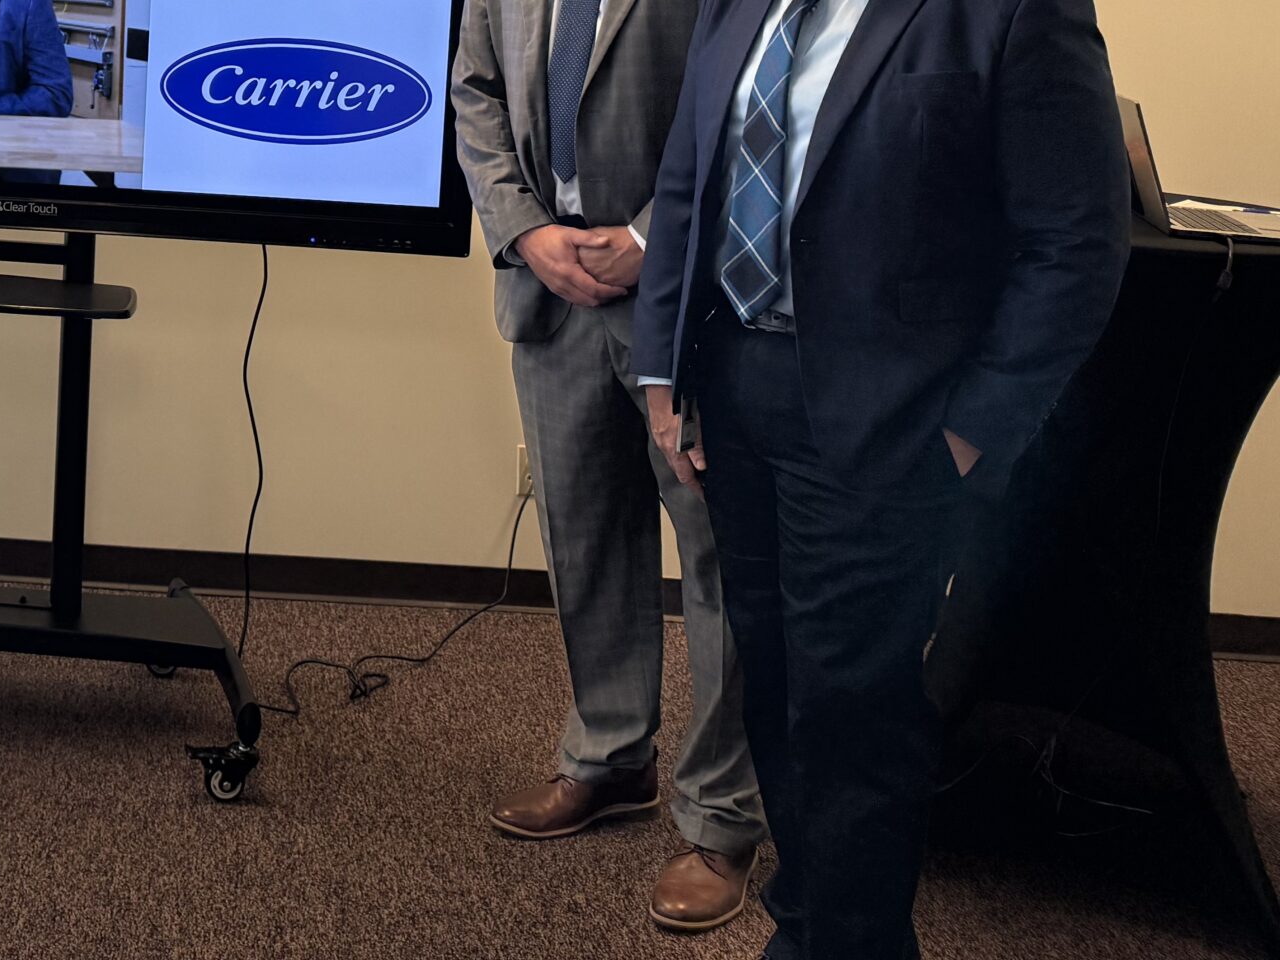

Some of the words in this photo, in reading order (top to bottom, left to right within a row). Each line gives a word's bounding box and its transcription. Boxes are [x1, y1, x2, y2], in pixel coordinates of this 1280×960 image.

[201, 65, 395, 113] Carrier
[3, 201, 27, 212] Clear
[28, 203, 58, 214] Touch
